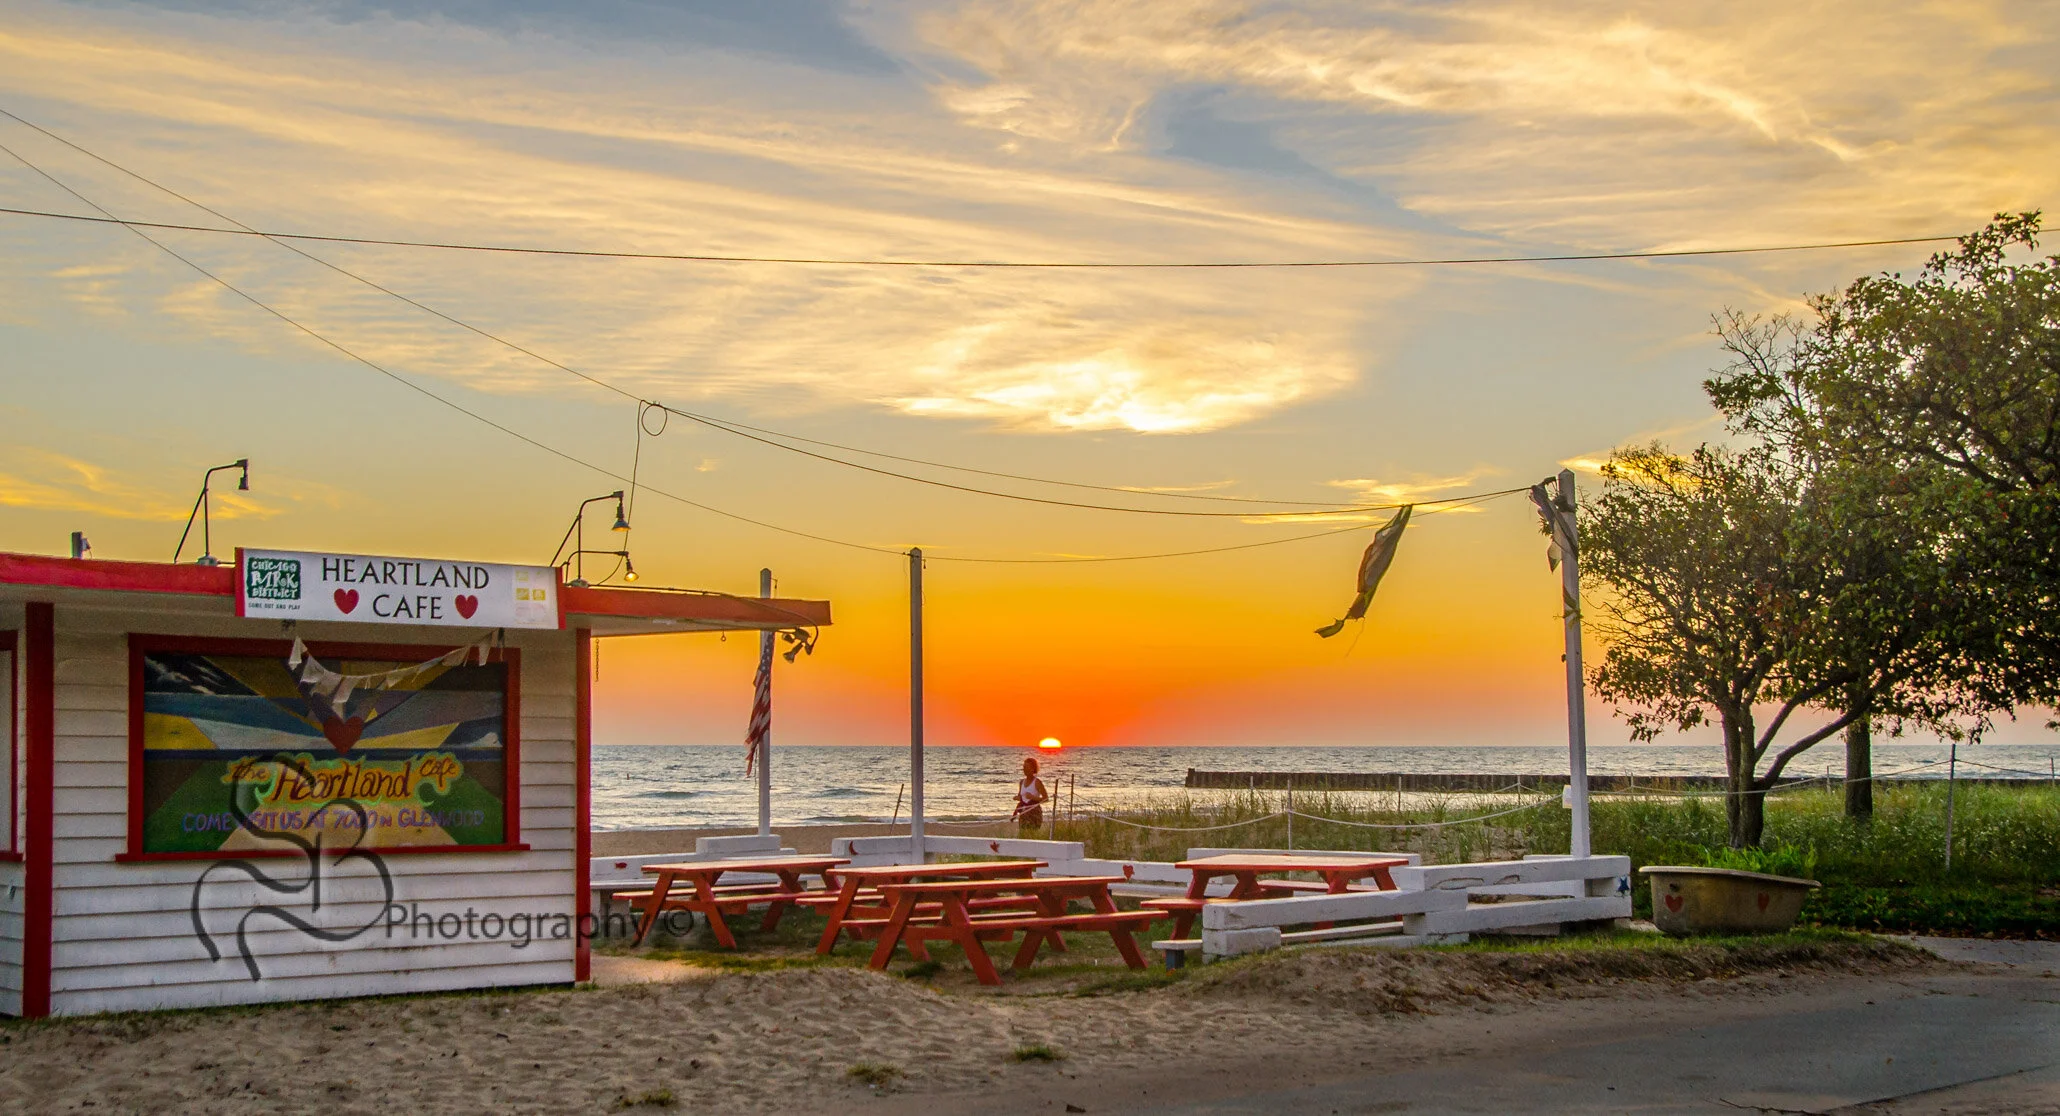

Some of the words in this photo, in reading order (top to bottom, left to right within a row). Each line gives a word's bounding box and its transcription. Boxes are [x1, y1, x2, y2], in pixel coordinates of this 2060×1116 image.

[251, 560, 298, 572] CHICAGO
[322, 557, 490, 590] HEARTLAND
[251, 570, 299, 589] PARK
[252, 587, 298, 599] DISTRICT
[372, 594, 443, 620] CAFE
[271, 759, 412, 801] Heartland
[183, 812, 232, 832] COME
[279, 810, 302, 830] US
[304, 808, 330, 829] AT
[397, 808, 485, 828] GLENWOOD
